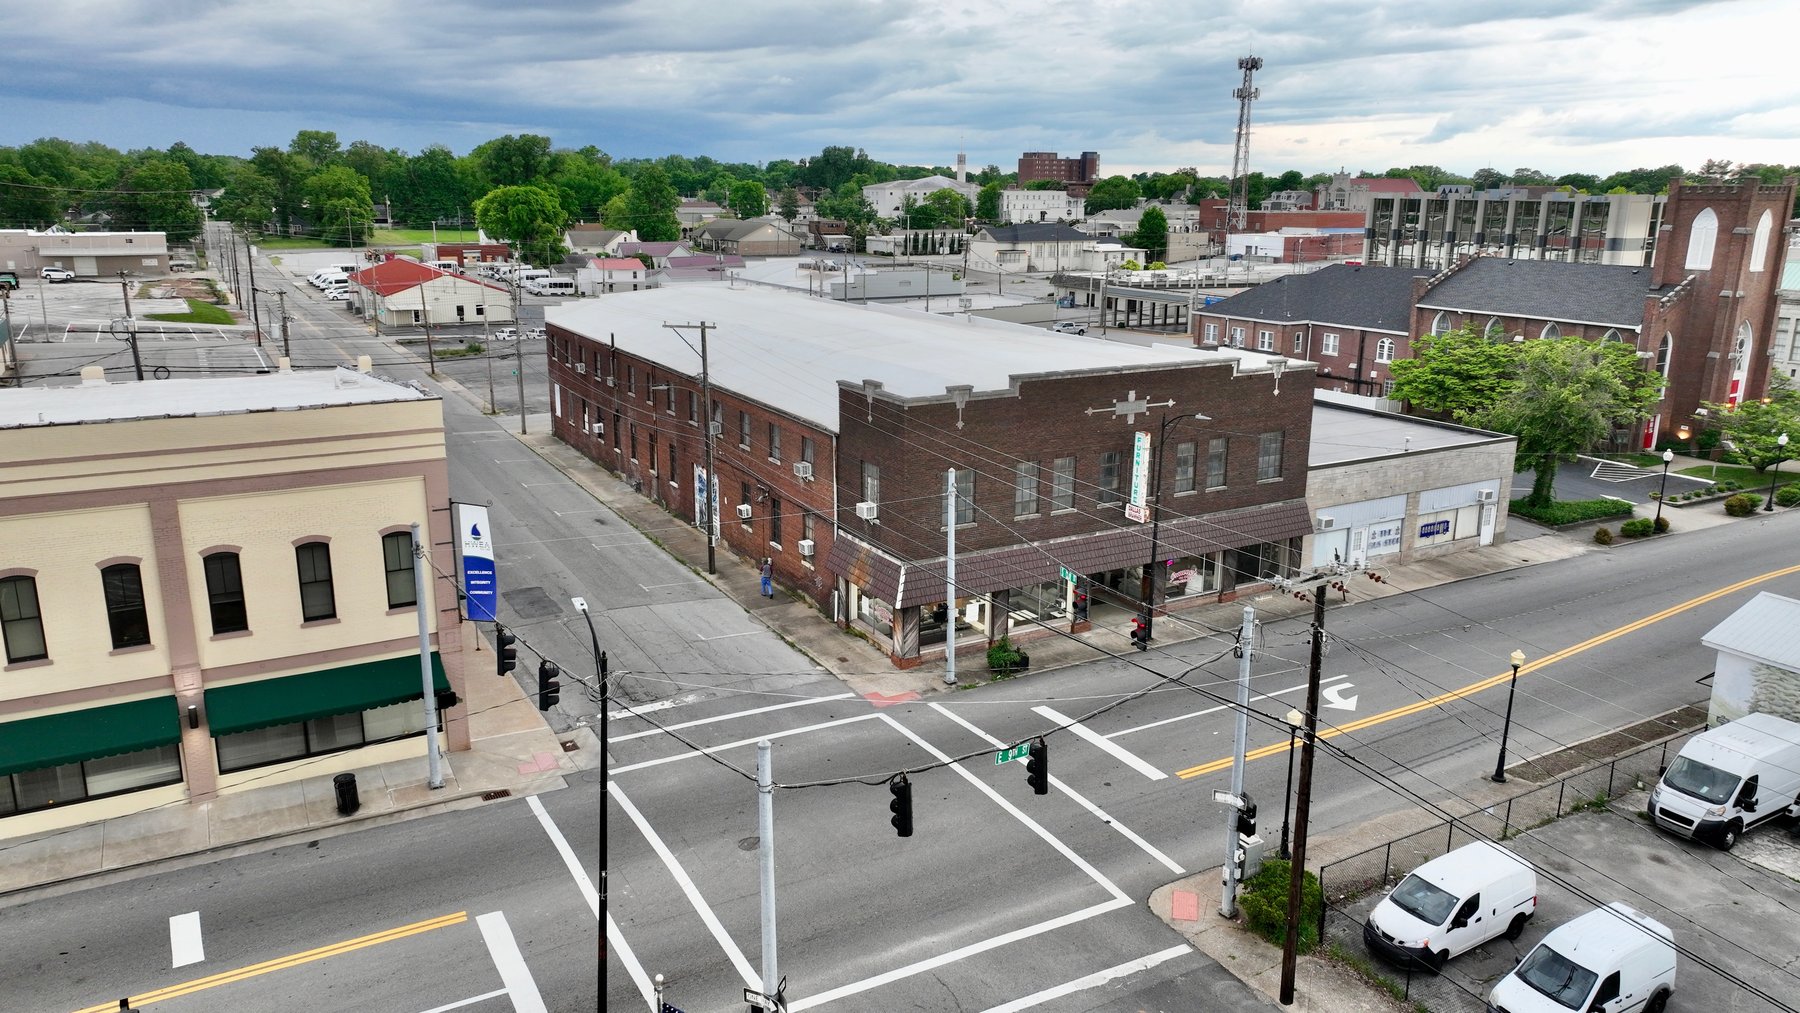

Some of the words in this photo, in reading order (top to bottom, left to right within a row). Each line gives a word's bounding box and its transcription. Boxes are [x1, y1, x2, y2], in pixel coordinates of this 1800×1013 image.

[1133, 437, 1142, 503] FURNITURE
[998, 751, 1003, 763] E
[1022, 744, 1028, 754] ST
